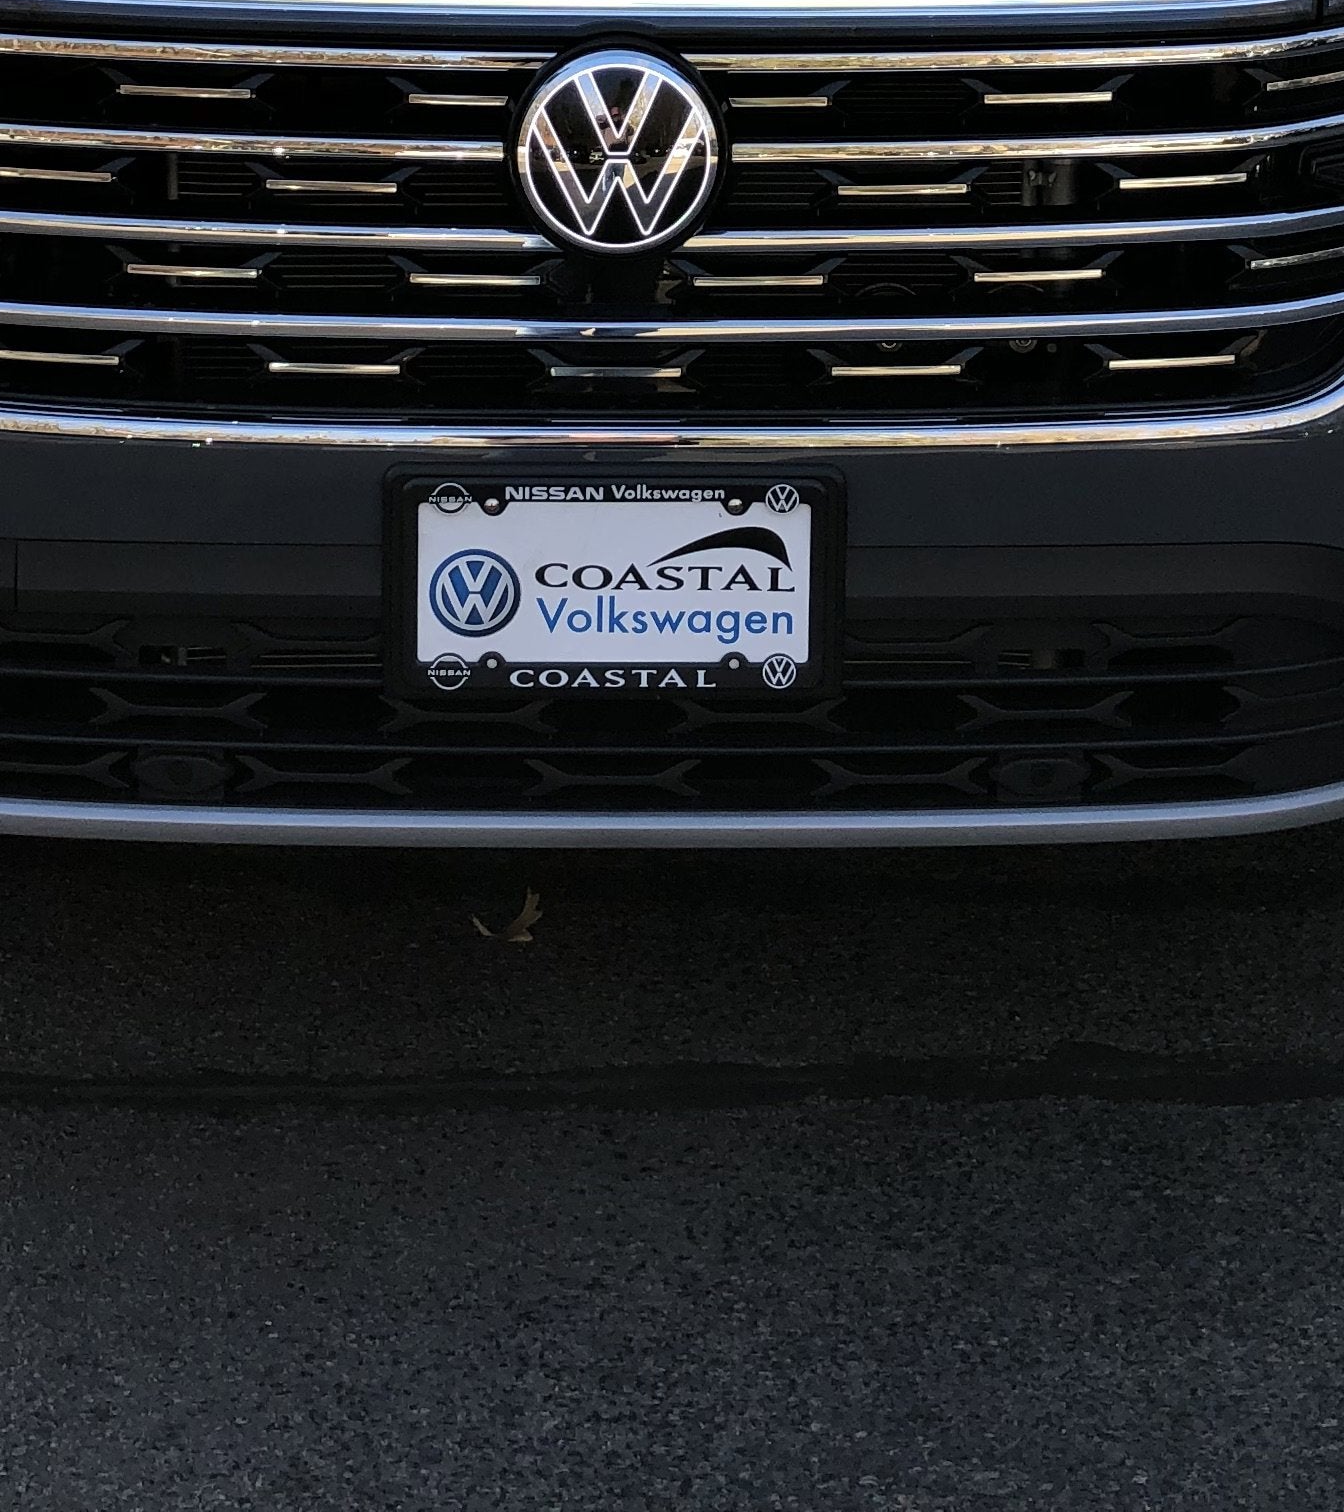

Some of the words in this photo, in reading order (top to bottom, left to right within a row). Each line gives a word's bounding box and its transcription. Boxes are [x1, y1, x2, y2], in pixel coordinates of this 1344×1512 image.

[428, 495, 472, 503] NISSAN
[505, 486, 604, 501] NISSAN
[611, 485, 725, 501] Volkswagen
[535, 562, 795, 592] COASTAL
[536, 595, 793, 644] Volkswagen
[427, 668, 471, 677] NISSAN
[509, 669, 717, 688] COASTAL
